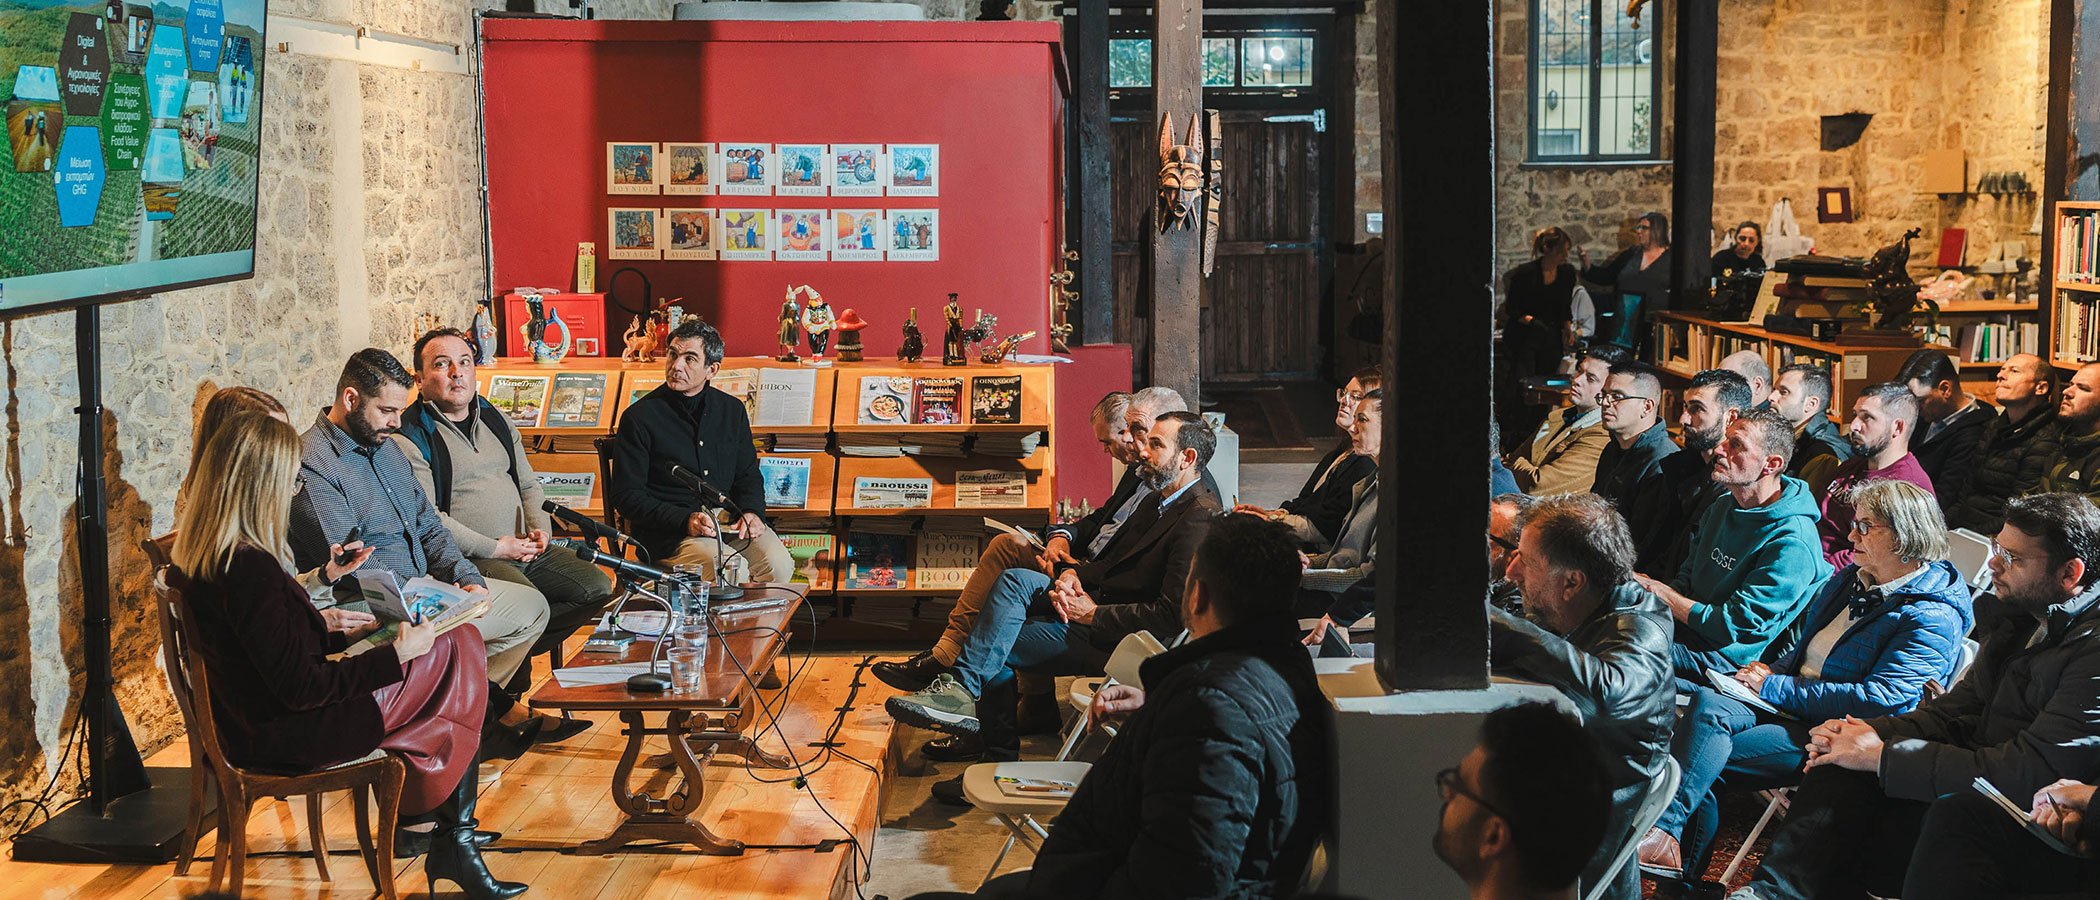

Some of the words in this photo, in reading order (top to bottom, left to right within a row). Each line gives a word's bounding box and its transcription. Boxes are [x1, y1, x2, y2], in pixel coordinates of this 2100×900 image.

[203, 23, 208, 34] &
[77, 34, 95, 49] Digital
[82, 54, 88, 65] &
[67, 67, 102, 83] Αγρονομικές
[68, 82, 100, 97] τεχνολογίες
[111, 135, 124, 146] Food
[125, 135, 139, 147] Value
[116, 148, 133, 160] Chain
[70, 156, 92, 170] Μείωση
[72, 183, 88, 195] GHG
[870, 482, 929, 490] naoussa
[925, 543, 974, 556] 1996
[921, 557, 973, 568] YEAR
